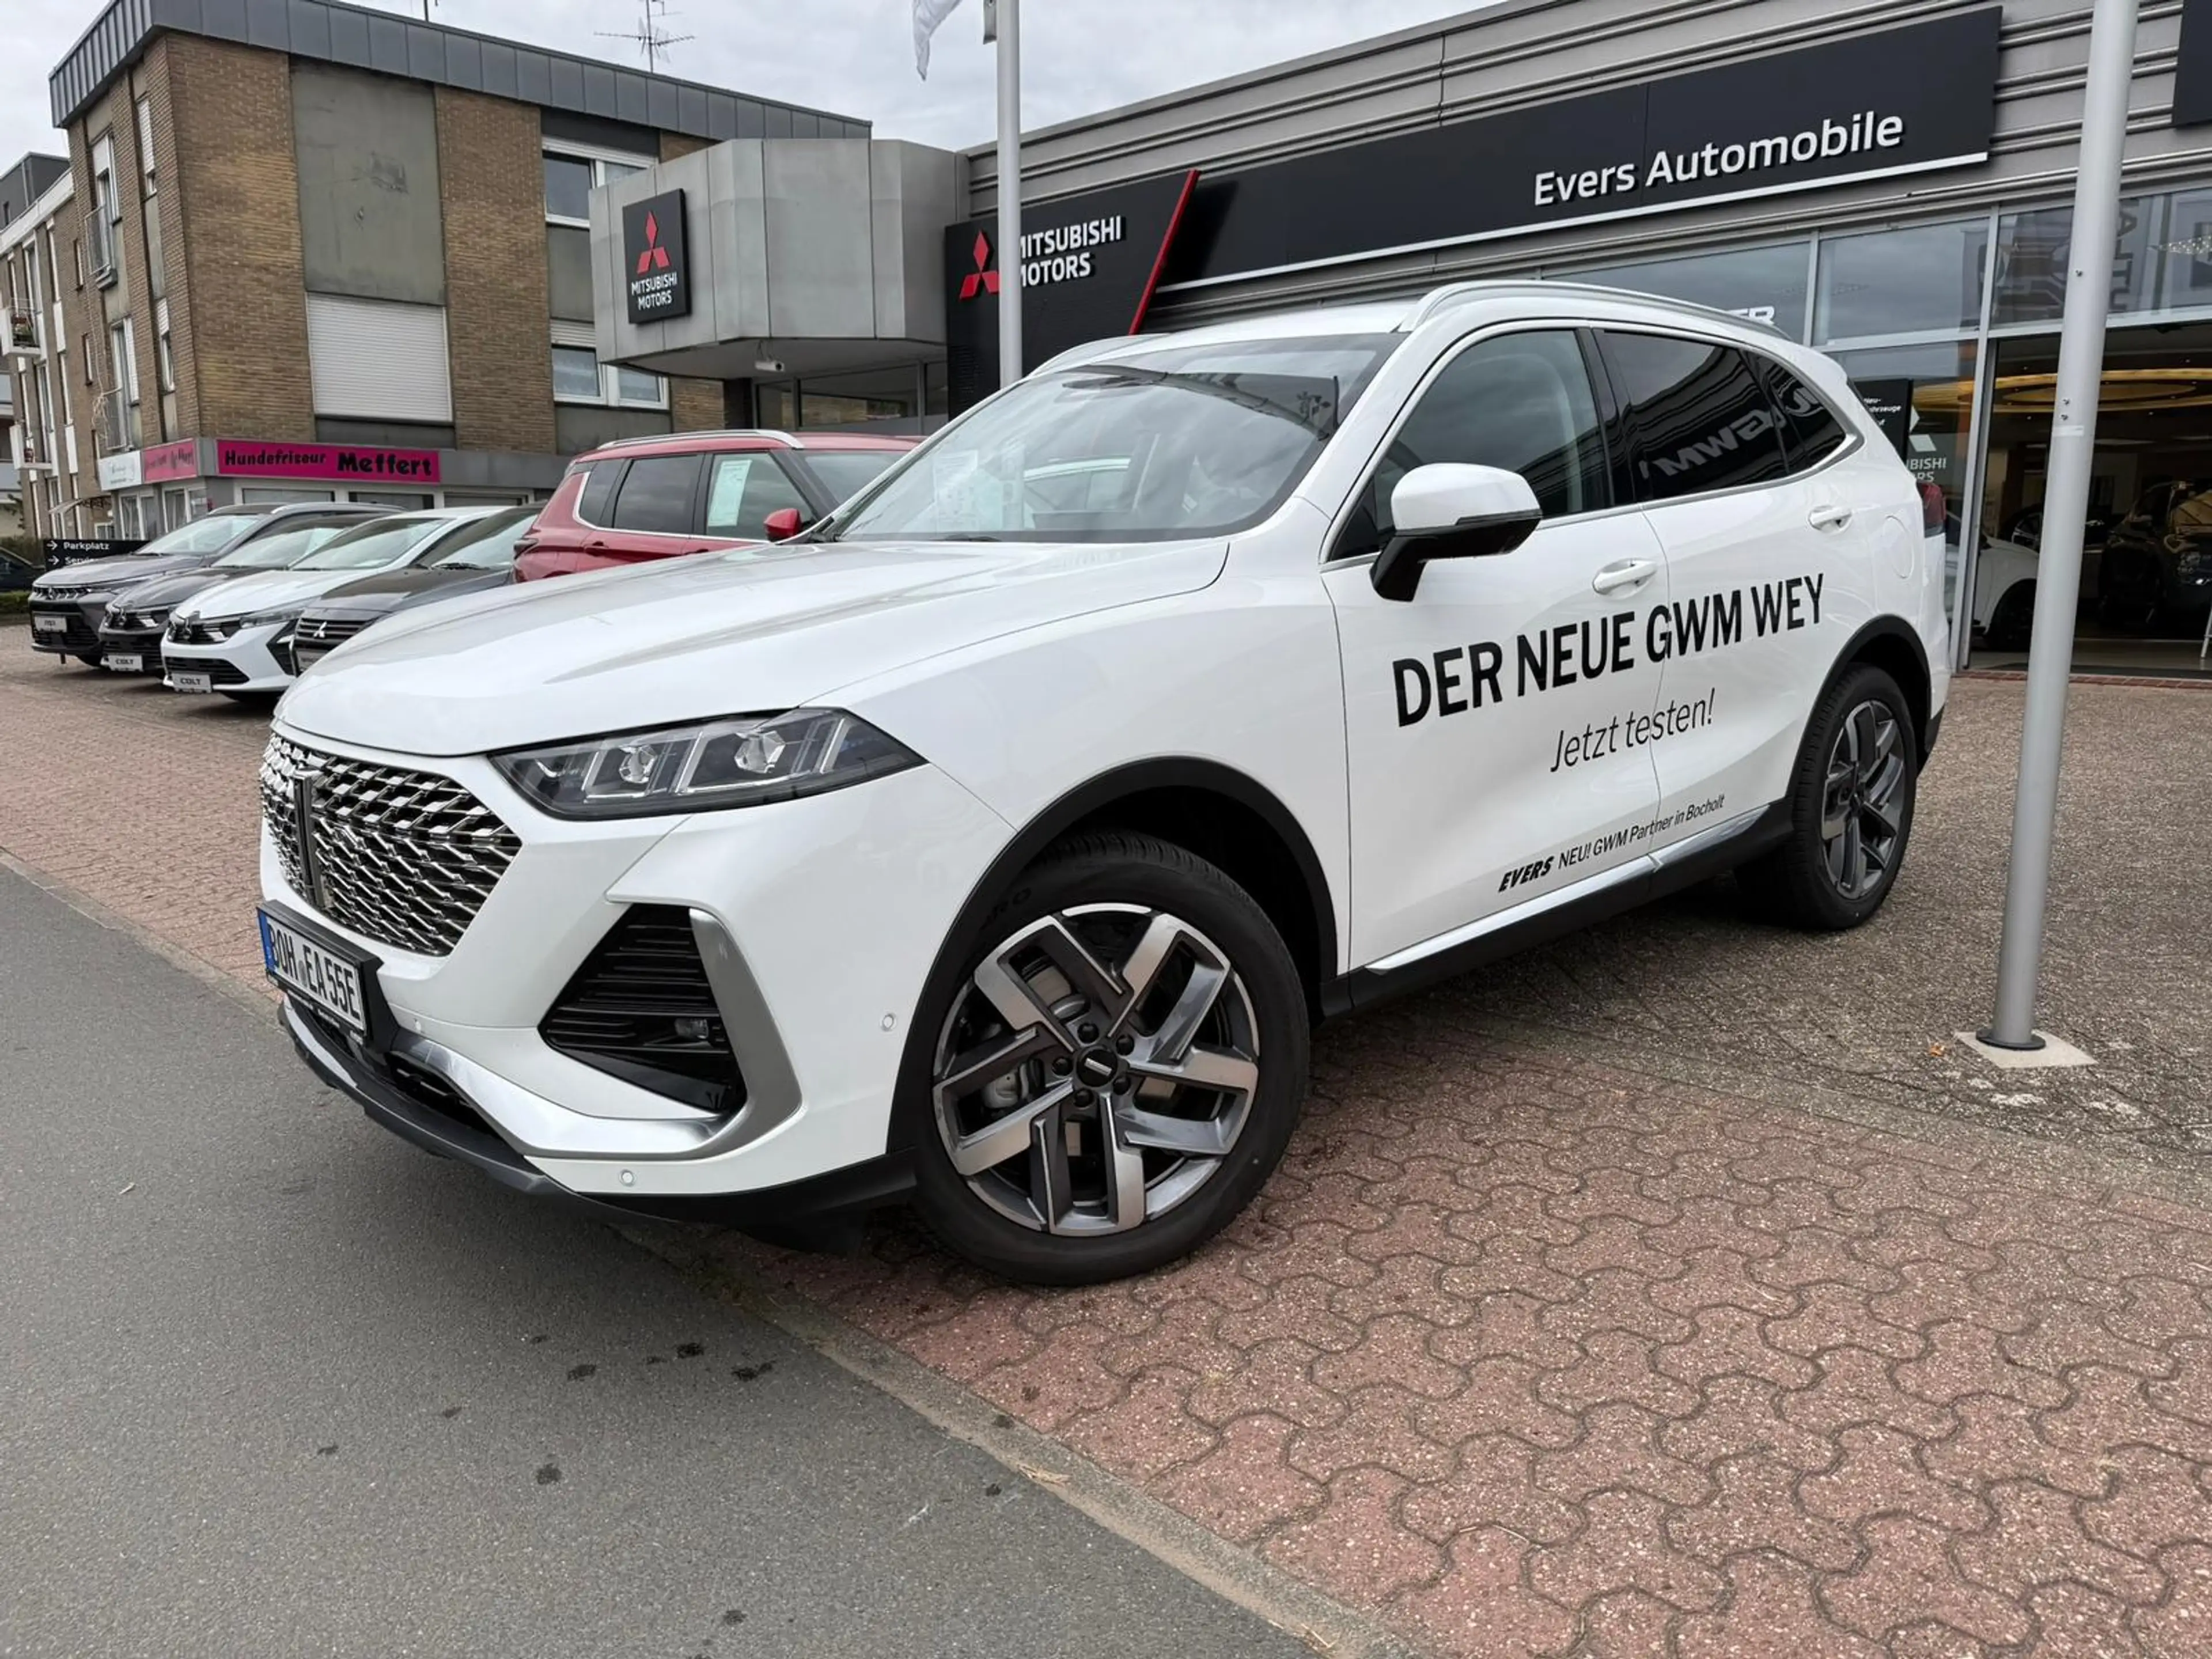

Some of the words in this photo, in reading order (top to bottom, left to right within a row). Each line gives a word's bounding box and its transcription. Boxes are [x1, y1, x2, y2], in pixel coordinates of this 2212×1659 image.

[1534, 162, 1635, 206] Evers
[1645, 111, 1903, 187] Automobile
[631, 271, 677, 296] MITSUBISHI
[638, 290, 672, 310] MOTORS
[225, 449, 325, 465] Hundefriseur
[337, 452, 432, 476] Meffert
[1907, 457, 1946, 469] BISHI
[63, 541, 109, 551] Parkplatz
[1392, 641, 1502, 727] DER
[1517, 611, 1635, 696] NEUE
[1646, 590, 1741, 662] GWM
[1751, 573, 1823, 637] WEY
[1550, 715, 1619, 772] Jetzt
[1626, 687, 1715, 748] testen!
[1498, 856, 1554, 892] EVERS
[1558, 842, 1592, 869] NEU!
[1593, 828, 1628, 856] GWM
[1629, 816, 1673, 843] Partner
[1674, 809, 1685, 825] in
[1686, 793, 1725, 821] Bocholt
[267, 922, 298, 980] BOH
[303, 944, 328, 1001] EA
[324, 956, 361, 1021] 55E
